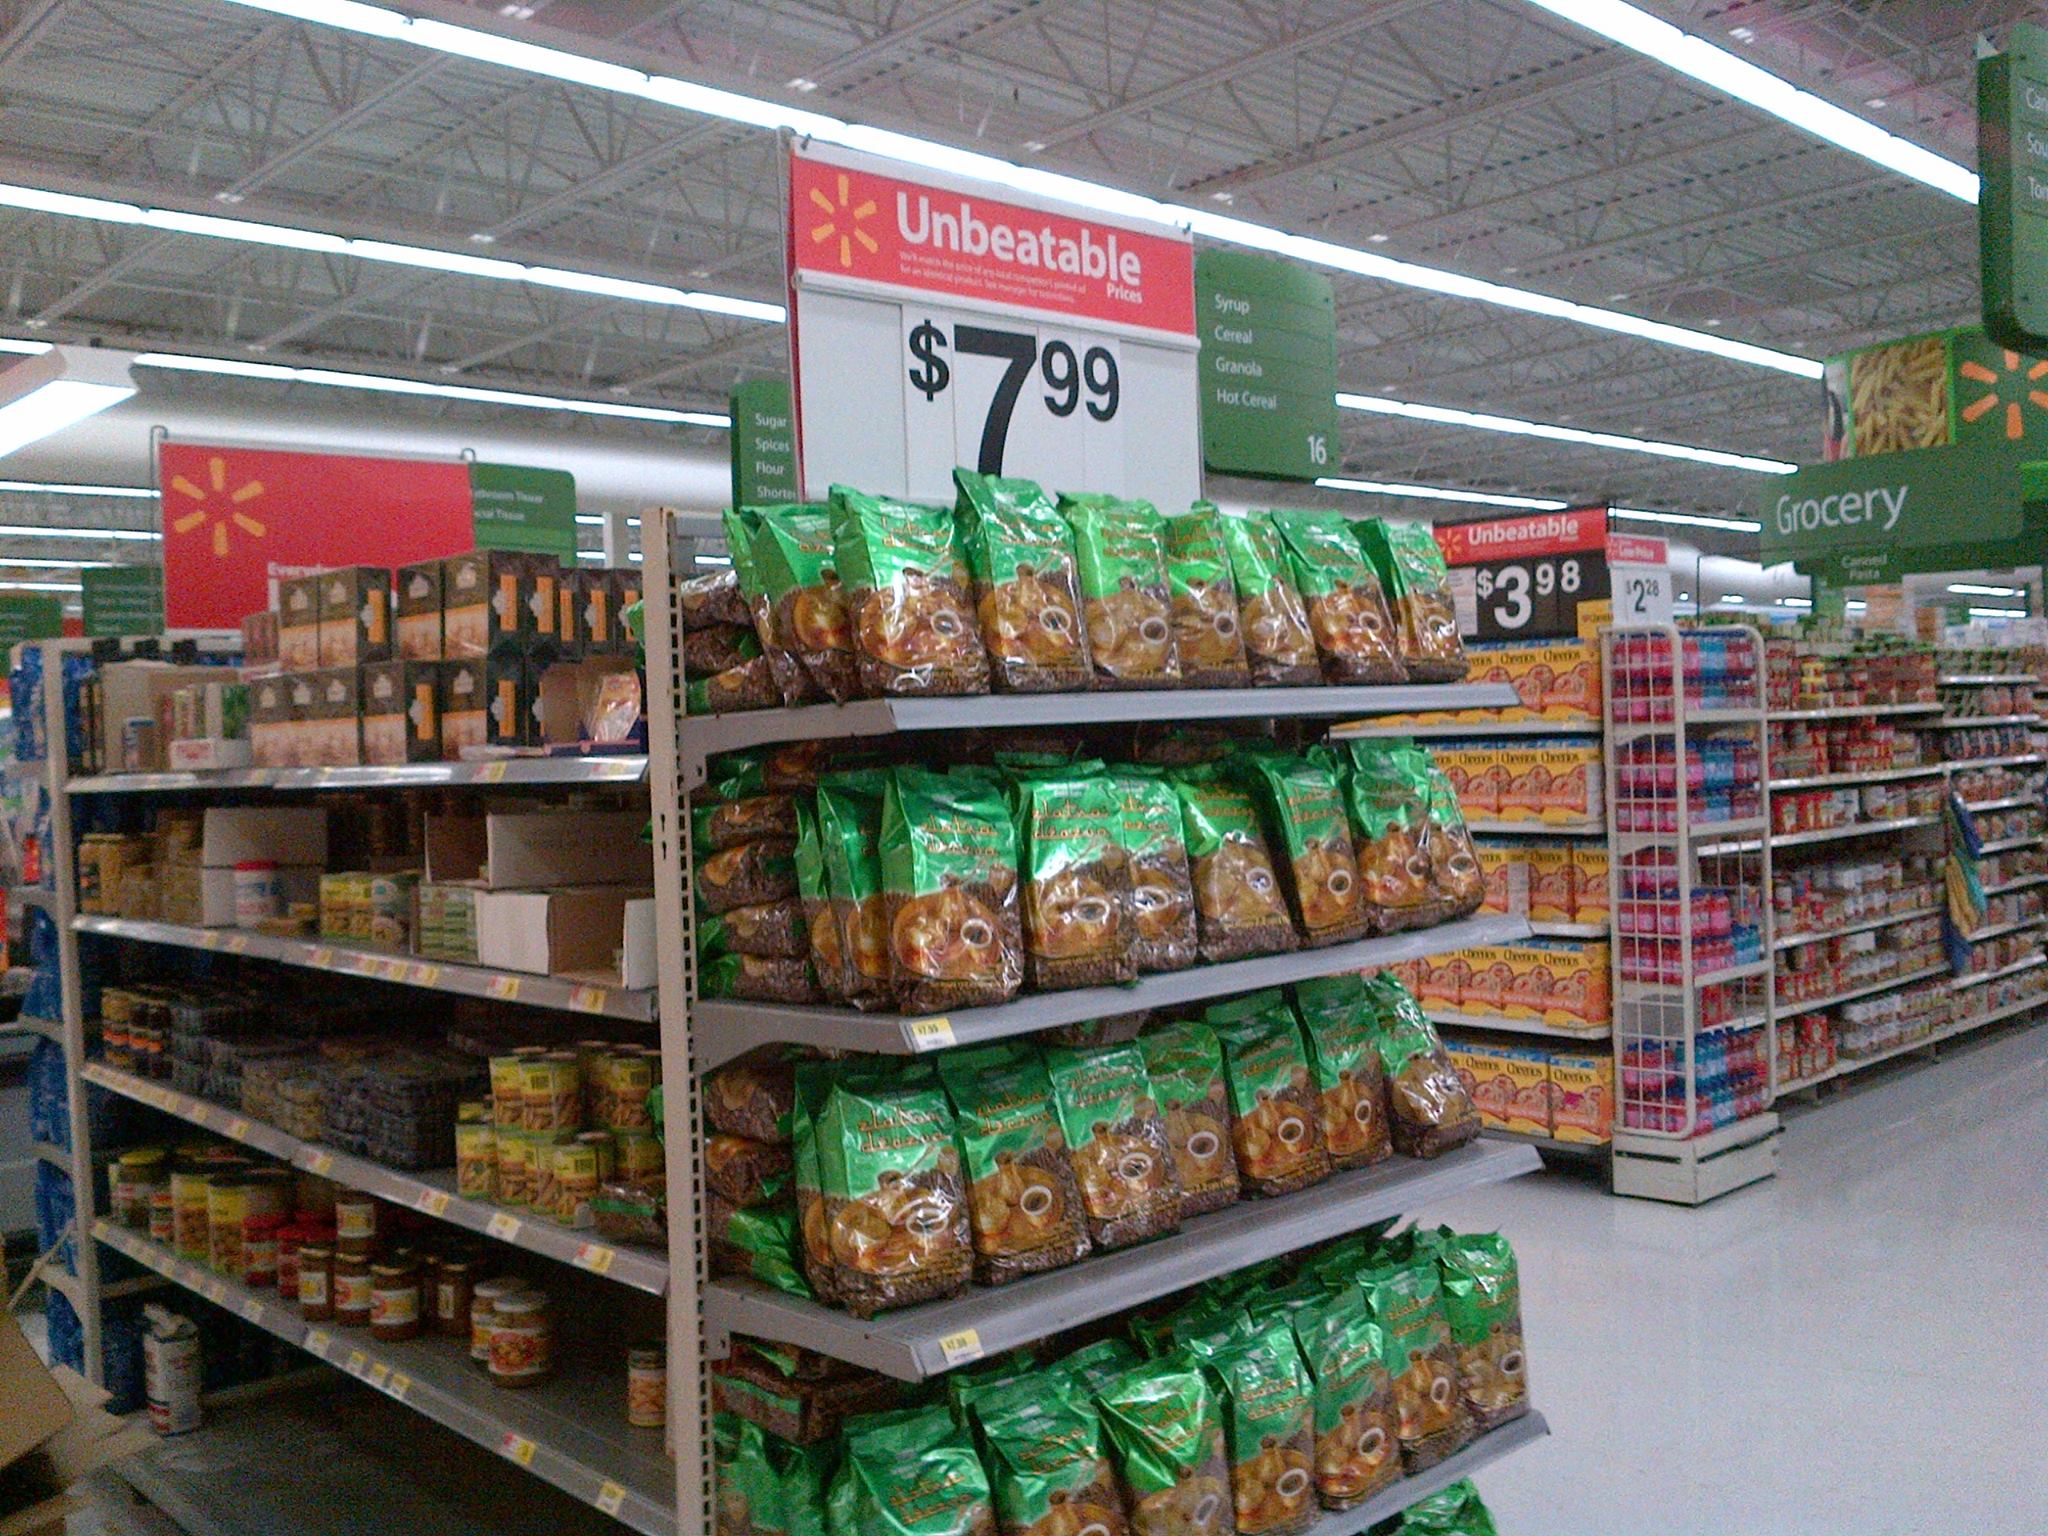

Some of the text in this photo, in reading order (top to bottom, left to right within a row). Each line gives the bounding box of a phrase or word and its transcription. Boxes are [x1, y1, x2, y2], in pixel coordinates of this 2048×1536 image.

[897, 191, 1141, 287] Unbeatable
[1107, 282, 1143, 304] Prices
[1215, 293, 1251, 316] Syrup
[1215, 324, 1253, 345] Cereal
[1216, 356, 1263, 378] Granola
[1216, 387, 1277, 410] Hot Cereal
[755, 412, 787, 430] Sugar
[755, 437, 790, 453] Spices
[1307, 433, 1327, 466] 16
[755, 461, 785, 476] Flour
[1776, 485, 1909, 535] Grocery
[1468, 514, 1579, 546] Unbeatable
